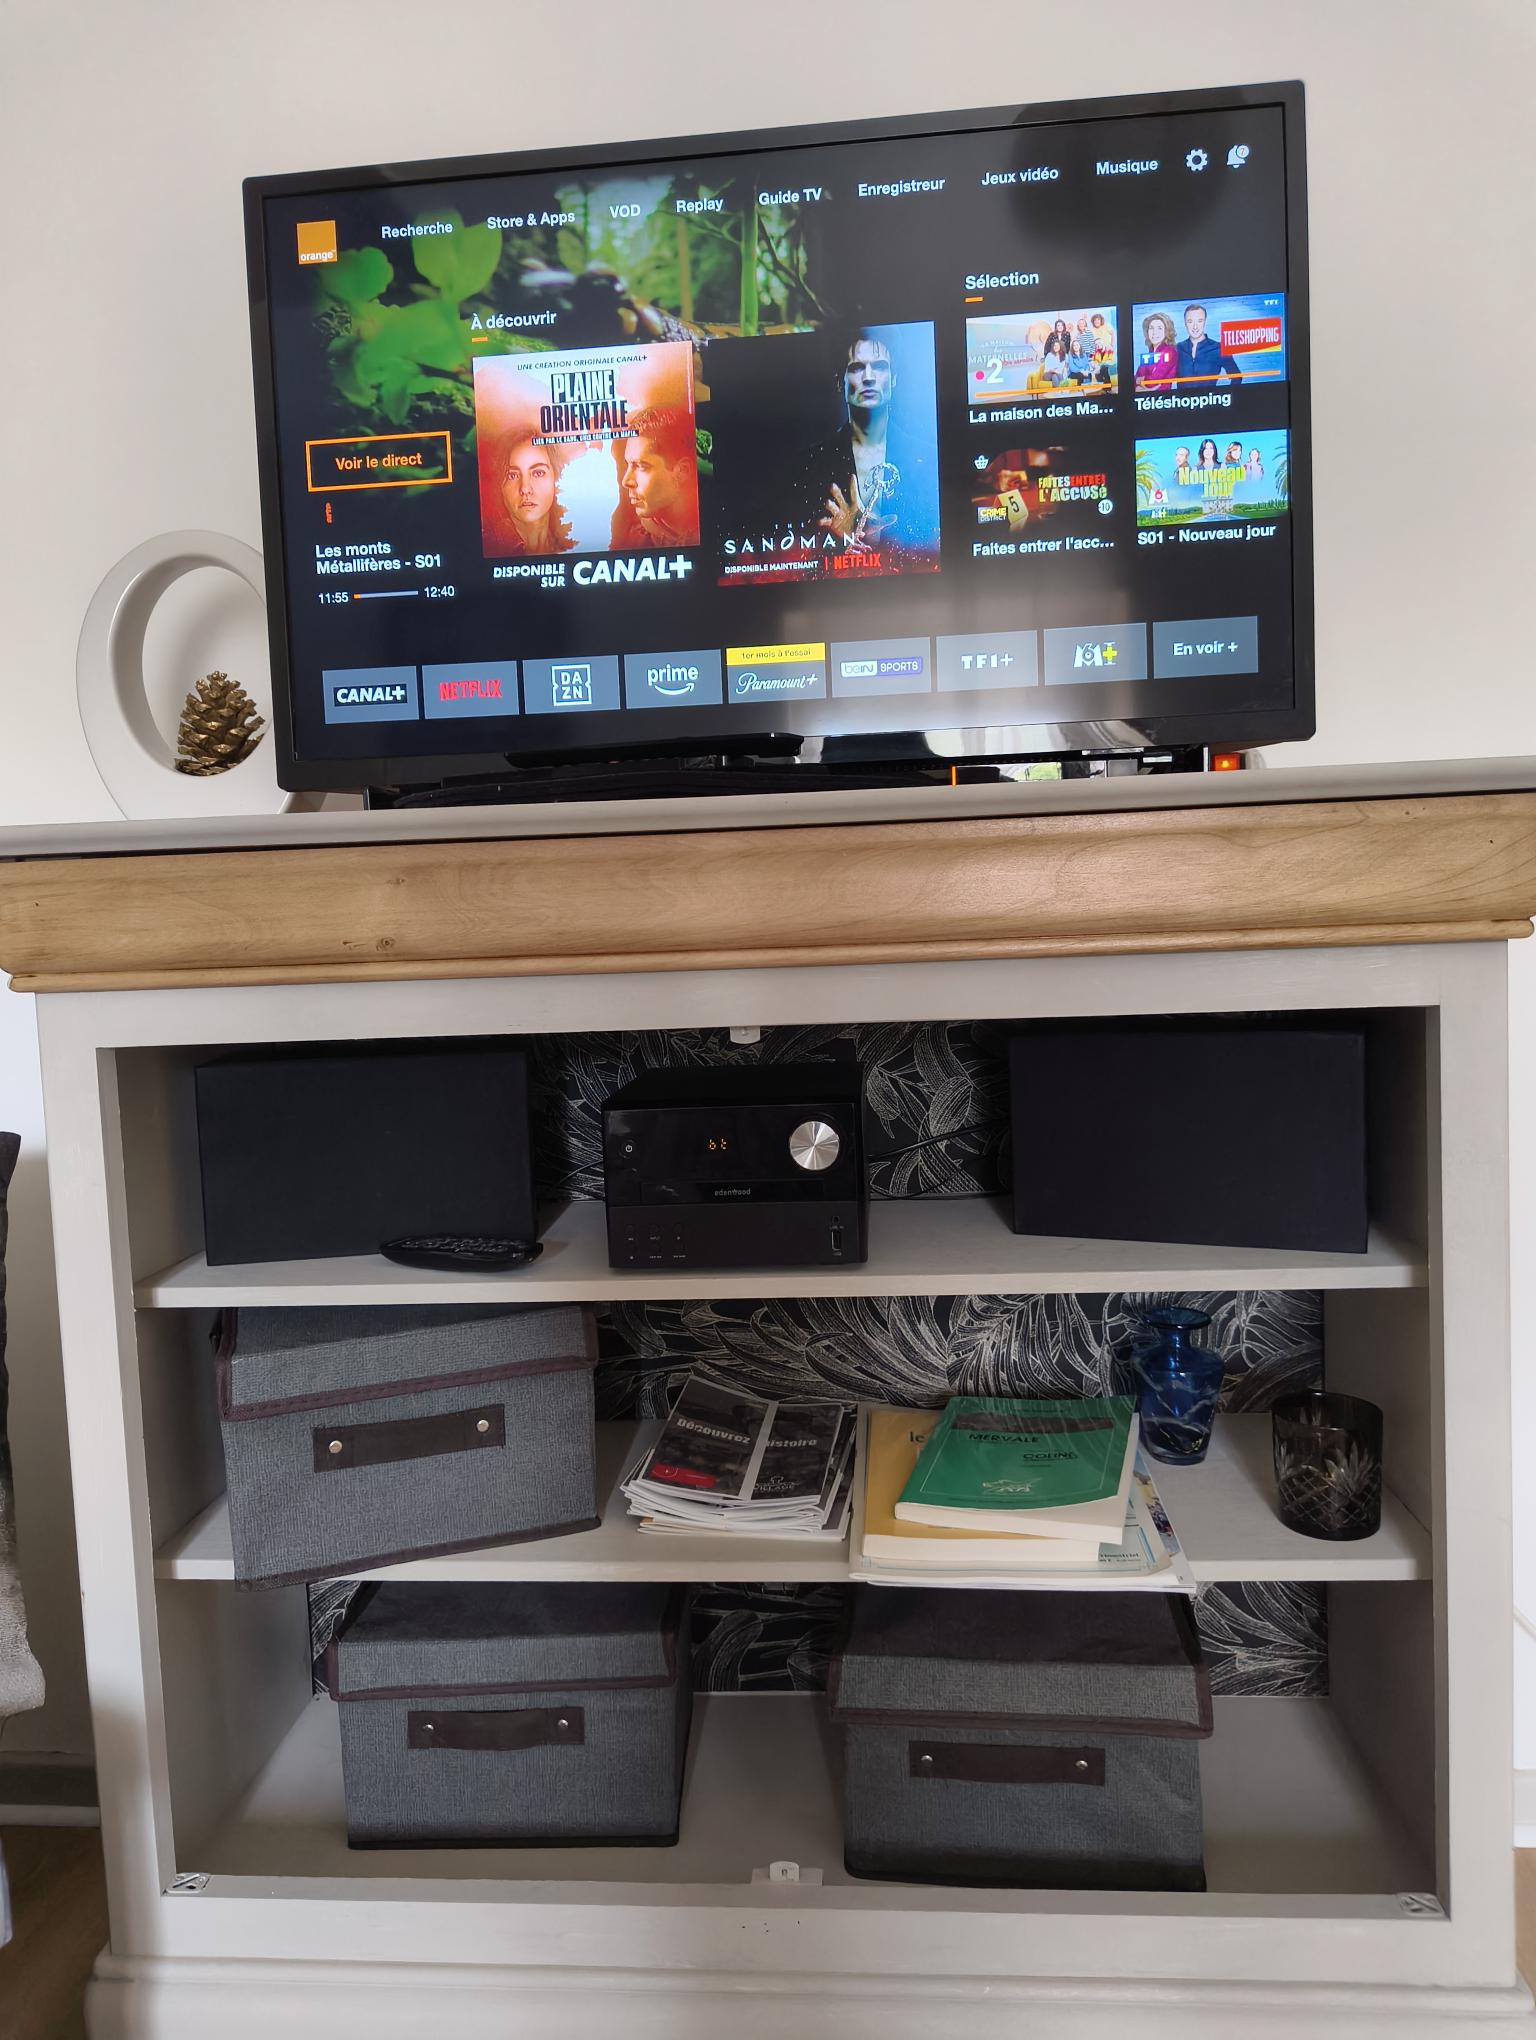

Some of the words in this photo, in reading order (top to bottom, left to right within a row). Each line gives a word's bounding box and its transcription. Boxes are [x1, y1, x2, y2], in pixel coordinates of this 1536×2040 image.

[981, 171, 1016, 186] Jeux
[1019, 167, 1059, 182] vidéo
[1096, 158, 1159, 176] Musique
[758, 190, 800, 206] Guide
[803, 187, 823, 201] TV
[858, 178, 945, 197] Enregistreur
[609, 204, 641, 219] VOD
[676, 199, 724, 214] Replay
[381, 221, 453, 239] Recherche
[487, 214, 525, 230] Store
[528, 213, 538, 227] &
[540, 211, 576, 229] Apps
[300, 250, 334, 262] orange
[965, 271, 1040, 290] Sélection
[471, 313, 483, 331] À
[485, 311, 557, 330] découvrir
[517, 363, 533, 371] UNE
[573, 357, 615, 366] ORIGINALE
[616, 354, 648, 363] CANAL+
[986, 358, 1004, 384] 2
[552, 370, 614, 403] PLAINE
[1135, 392, 1232, 411] Téléshopping
[540, 400, 628, 434] ORIENTALE
[969, 409, 987, 424] La
[991, 406, 1043, 422] maison
[1046, 403, 1073, 418] des
[1076, 402, 1114, 416] Ma...
[335, 456, 363, 471] Voir
[366, 455, 379, 469] le
[381, 452, 423, 467] direct
[980, 507, 1007, 517] CRIME
[1008, 496, 1019, 513] 5
[724, 530, 856, 554] SANDMAN
[1137, 531, 1164, 545] S01
[1179, 528, 1243, 542] Nouveau
[1246, 525, 1276, 541] jour
[315, 544, 342, 558] Les
[345, 541, 392, 556] monts
[973, 542, 1015, 557] Faites
[1019, 539, 1062, 553] entrer
[1065, 537, 1115, 550] l'acc...
[316, 556, 401, 575] Métallifères
[415, 554, 441, 569] S01
[493, 563, 565, 578] DISPONIBLE
[572, 554, 693, 586] CANAL+
[724, 562, 769, 574] DISPONIBLE
[769, 560, 818, 572] MAINTENANT
[833, 553, 881, 570] NETFLIX
[541, 576, 565, 588] SUR
[318, 592, 349, 604] 11:55
[424, 586, 455, 599] 12:40
[1173, 642, 1193, 656] En
[1196, 640, 1224, 654] voir
[648, 663, 699, 687] prime
[880, 660, 918, 673] SPORTS
[438, 677, 502, 701] NETFLIX
[735, 672, 818, 695] Paramount+
[336, 685, 405, 704] CANAL+
[677, 1418, 751, 1444] Découvrez
